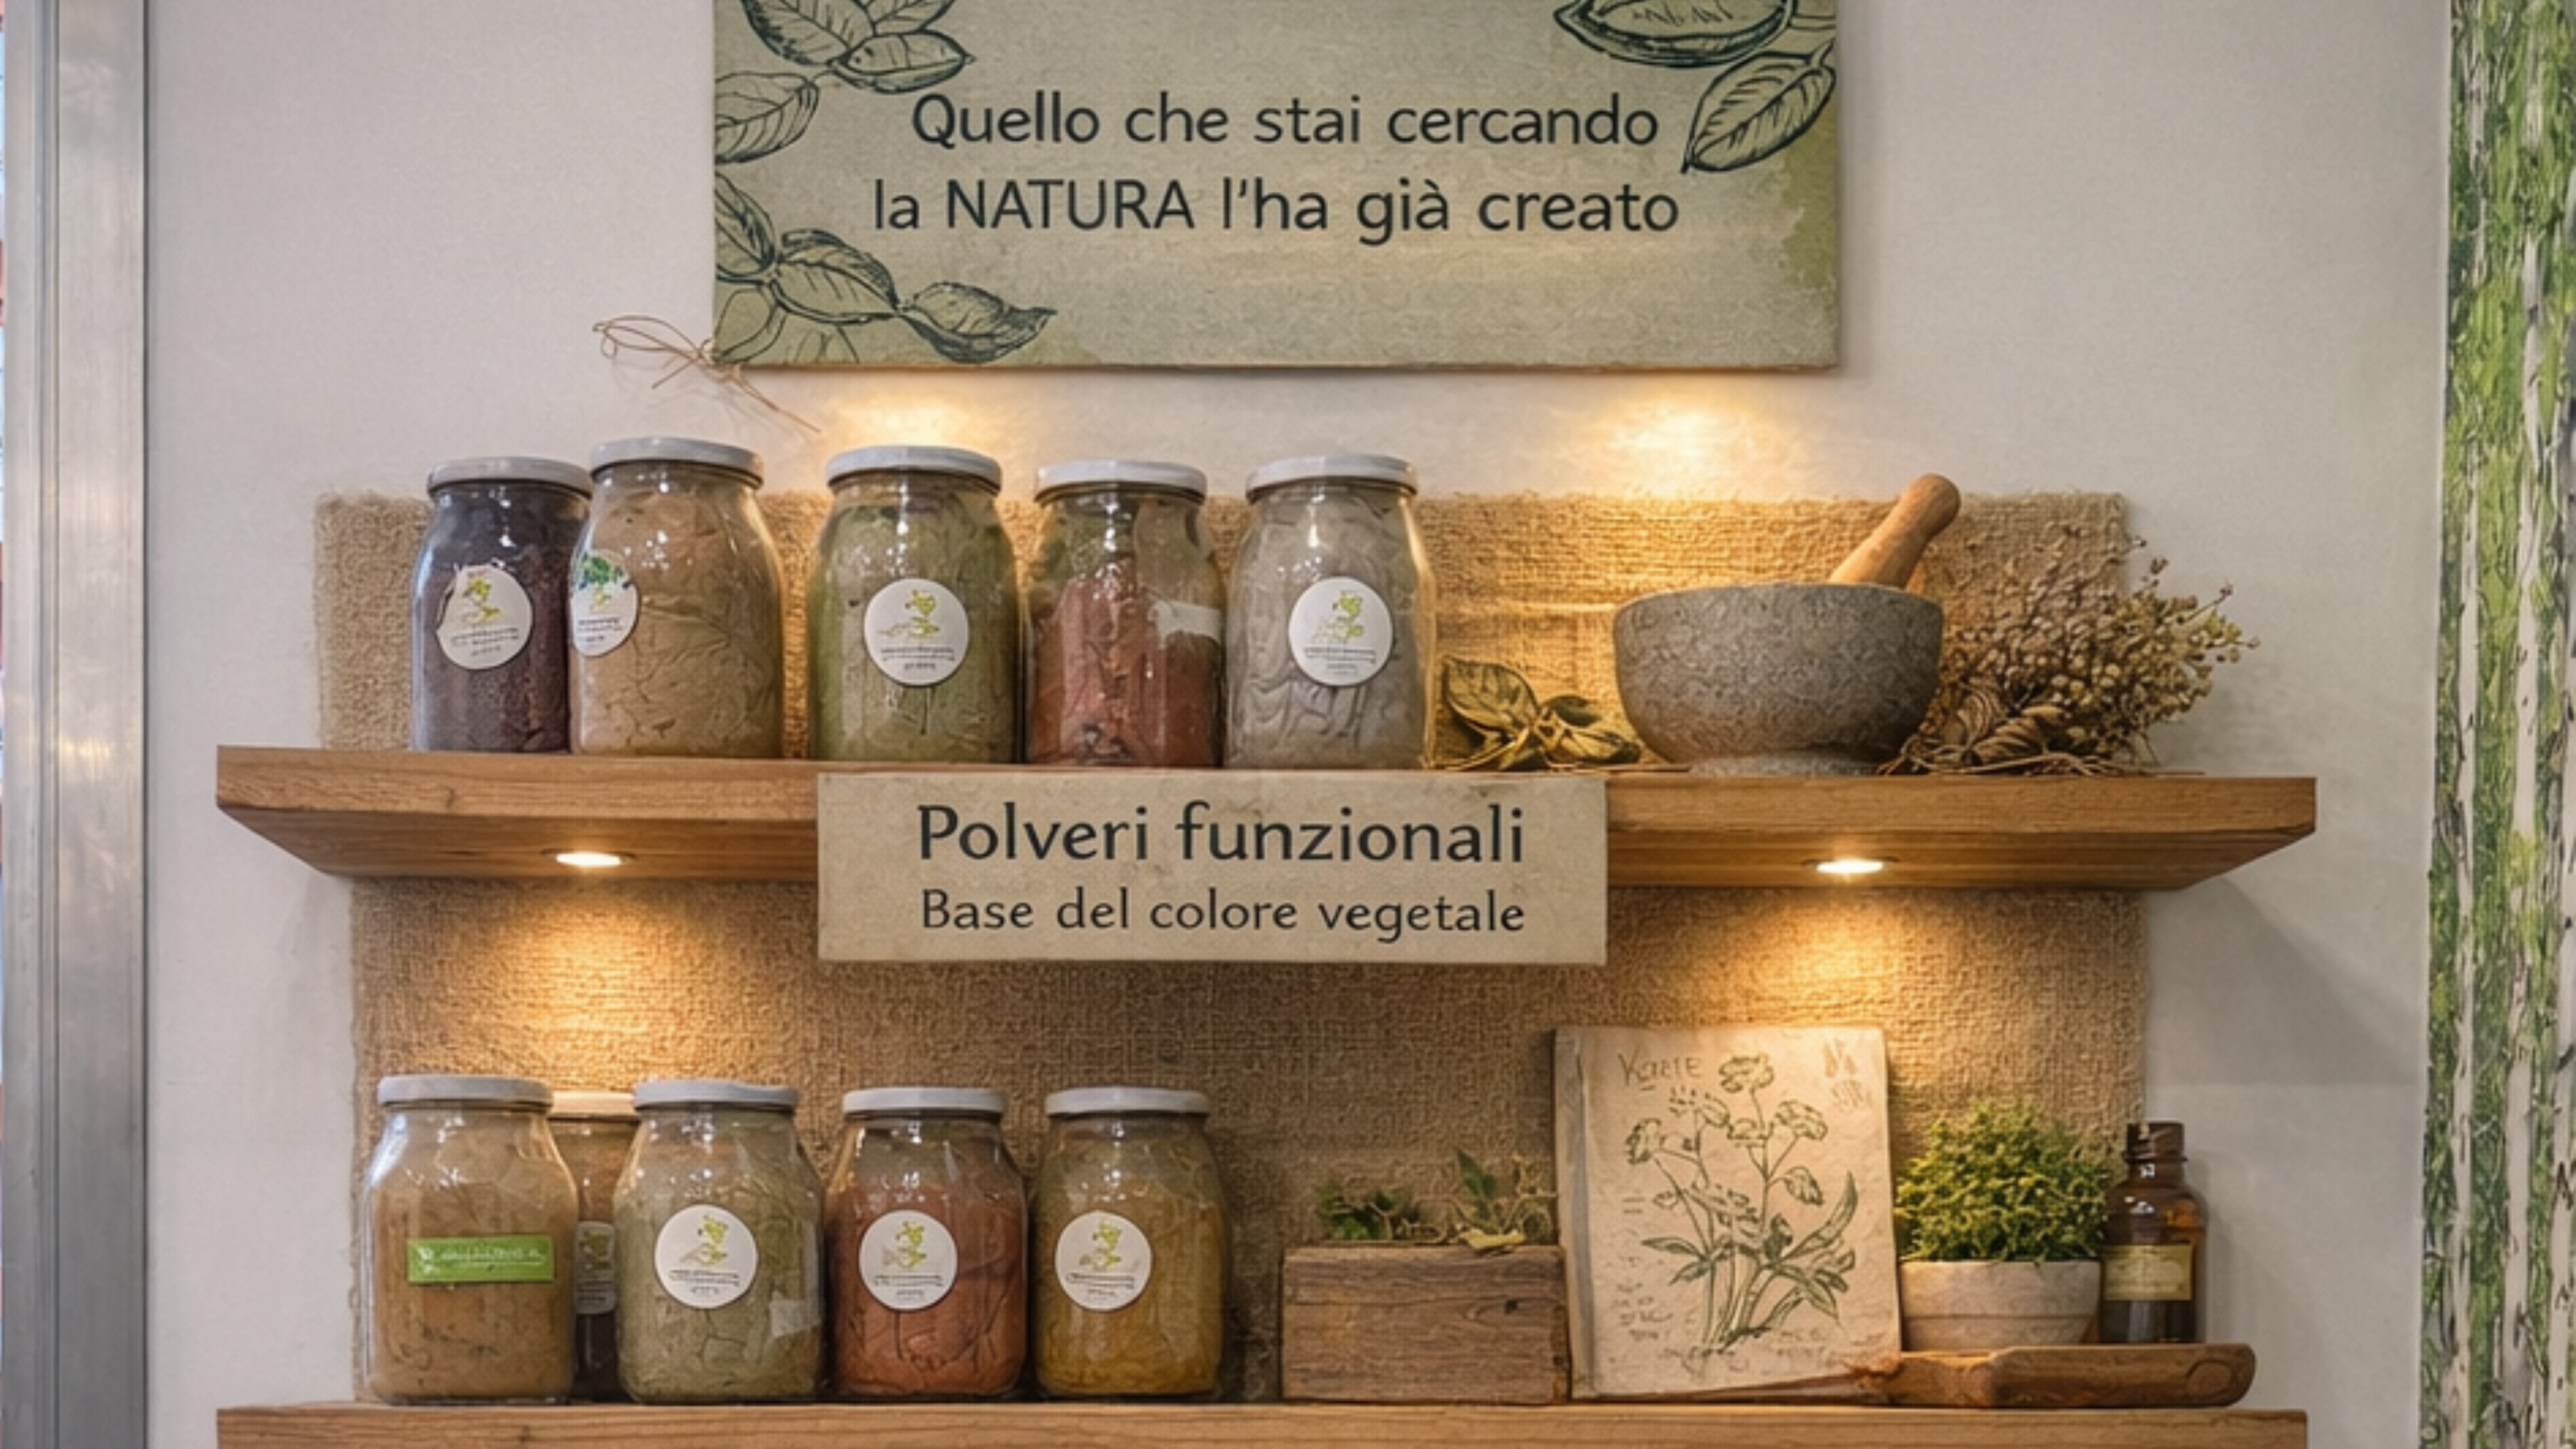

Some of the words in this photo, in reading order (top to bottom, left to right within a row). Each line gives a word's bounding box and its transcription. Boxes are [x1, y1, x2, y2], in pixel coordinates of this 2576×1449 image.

[912, 90, 1101, 150] Quello
[1125, 90, 1229, 144] che
[1253, 94, 1361, 144] stai
[1387, 92, 1659, 147] cercando
[875, 178, 919, 230] la
[947, 179, 1196, 231] NATURA
[1222, 176, 1328, 231] l'ha
[1356, 177, 1450, 247] già
[1477, 183, 1679, 232] creato
[918, 803, 1148, 862] Polveri
[1174, 799, 1524, 863] funzionali
[922, 888, 1034, 930] Base
[1056, 885, 1129, 930] del
[1149, 887, 1297, 930] colore
[1317, 888, 1524, 944] vegetale
